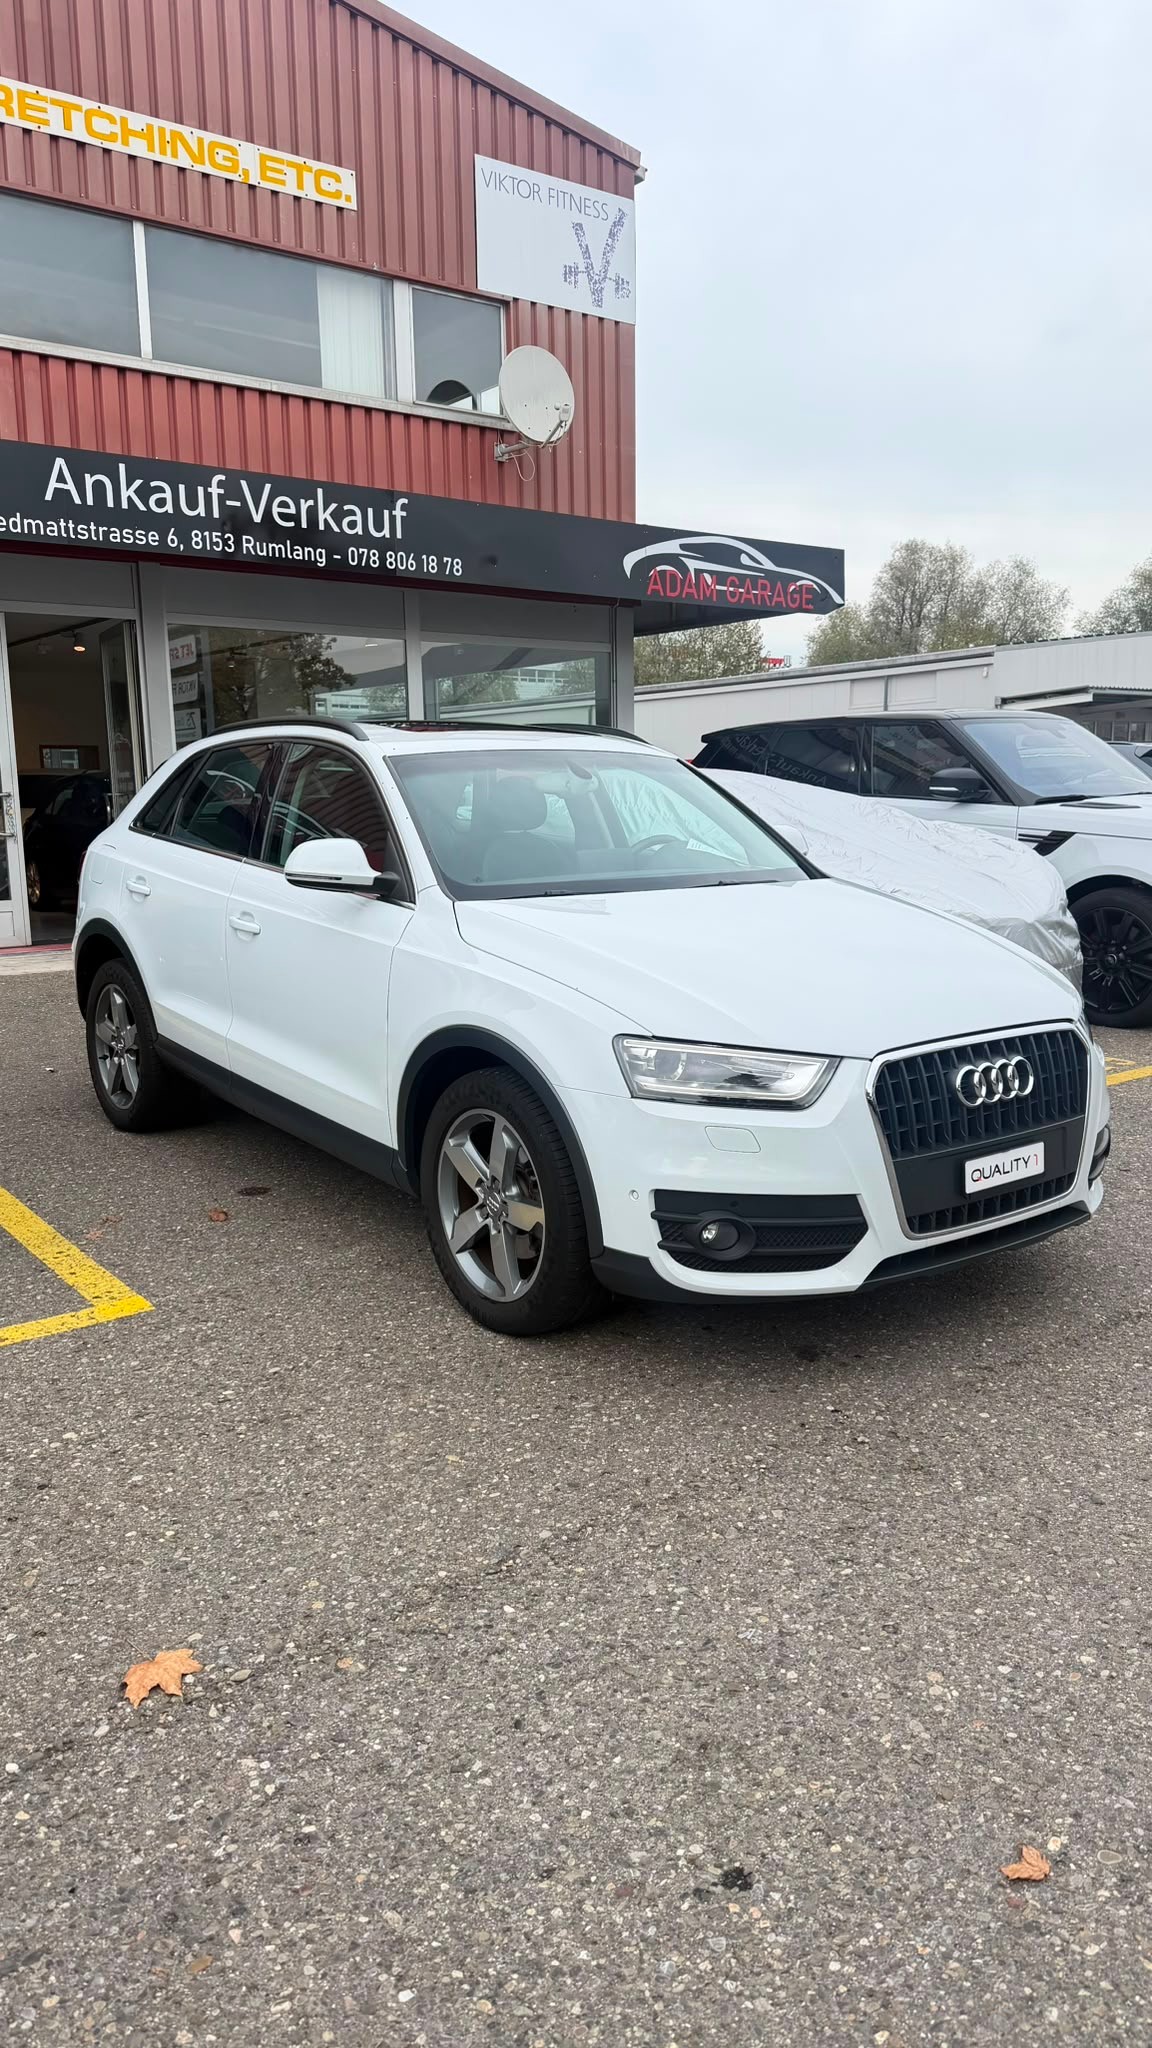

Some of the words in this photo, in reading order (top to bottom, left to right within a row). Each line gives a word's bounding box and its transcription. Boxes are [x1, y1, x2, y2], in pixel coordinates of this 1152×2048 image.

[481, 167, 542, 203] VIKTOR
[548, 187, 609, 221] FITNESS
[44, 457, 409, 539] Ankauf-Verkauf
[0, 512, 159, 546] edmattstrasse
[167, 528, 184, 551] 6,
[191, 530, 235, 553] 8153
[242, 535, 327, 567] Rumlang
[348, 547, 380, 568] 078
[386, 551, 416, 571] 806
[421, 554, 438, 574] 18
[443, 557, 463, 576] 78
[647, 567, 717, 602] ADAM
[726, 576, 814, 609] GARAGE
[970, 1154, 1031, 1182] QUALITY
[1033, 1153, 1038, 1166] 1
